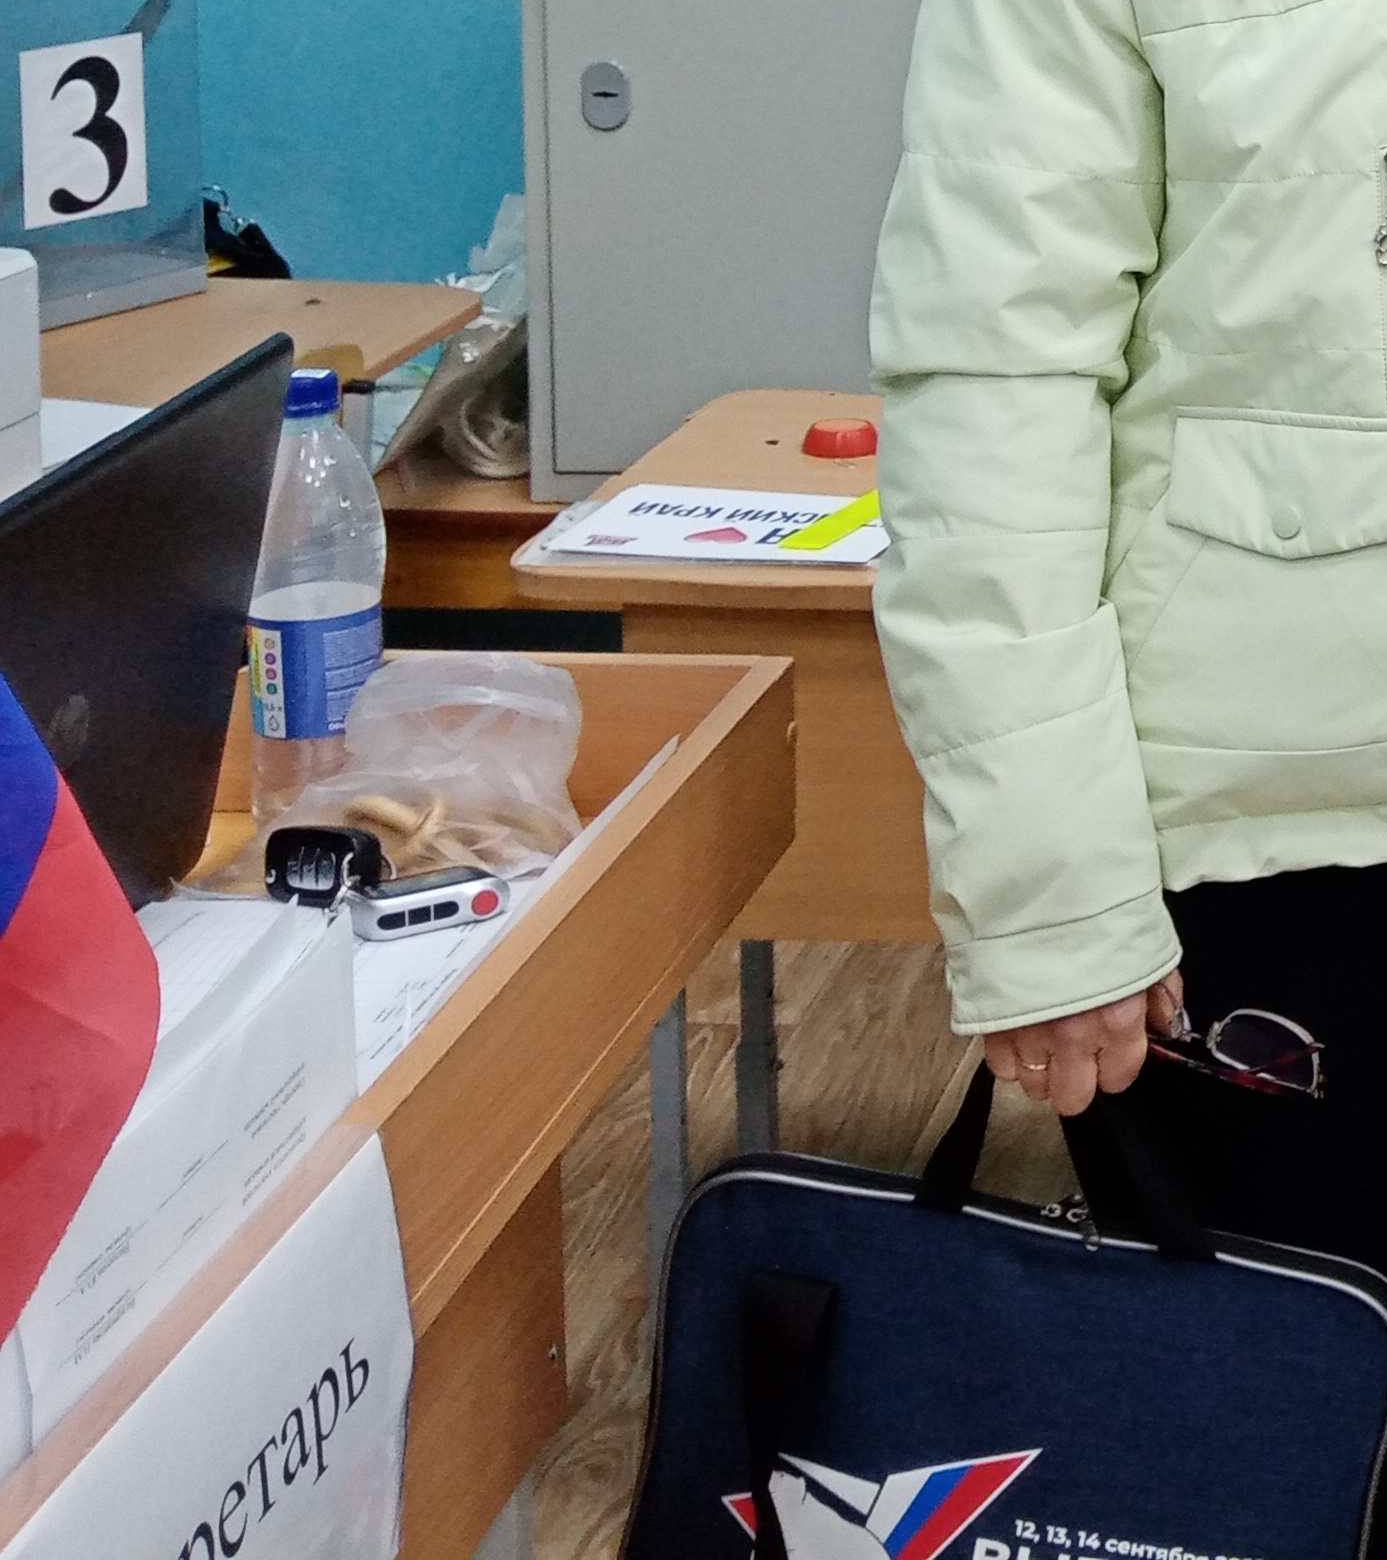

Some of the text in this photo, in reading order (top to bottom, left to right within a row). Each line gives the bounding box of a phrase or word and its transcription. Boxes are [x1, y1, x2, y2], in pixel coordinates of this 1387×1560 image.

[48, 55, 129, 216] 3
[1014, 1519, 1040, 1543] 12,
[1046, 1525, 1072, 1548] 13,
[1078, 1530, 1101, 1551] 14
